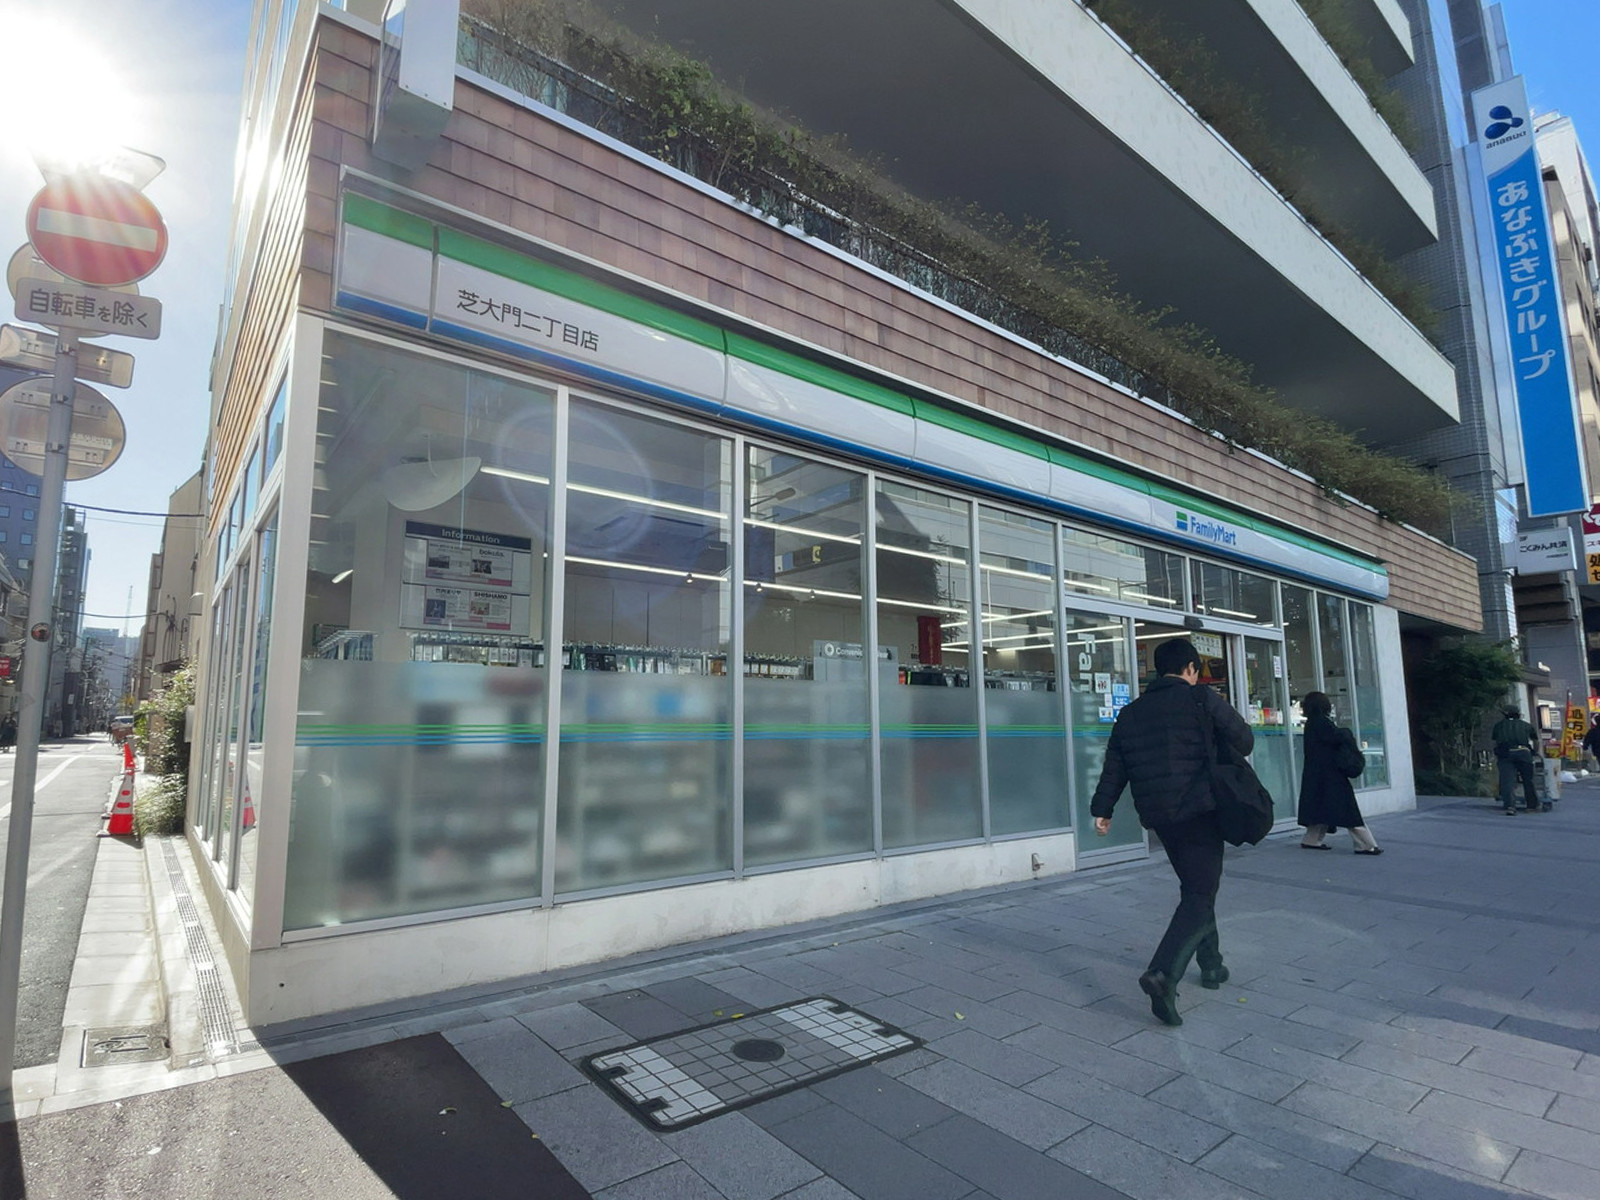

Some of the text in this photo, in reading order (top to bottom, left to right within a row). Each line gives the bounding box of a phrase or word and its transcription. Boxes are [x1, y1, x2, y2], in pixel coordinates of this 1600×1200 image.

[1497, 180, 1556, 380] あなぶきグループ
[30, 289, 148, 328] 自転車を除く
[457, 289, 600, 352] 芝大門二丁目店
[442, 529, 500, 544] Information
[1191, 517, 1236, 546] FamilyMart
[1520, 541, 1568, 552] こくみん共済
